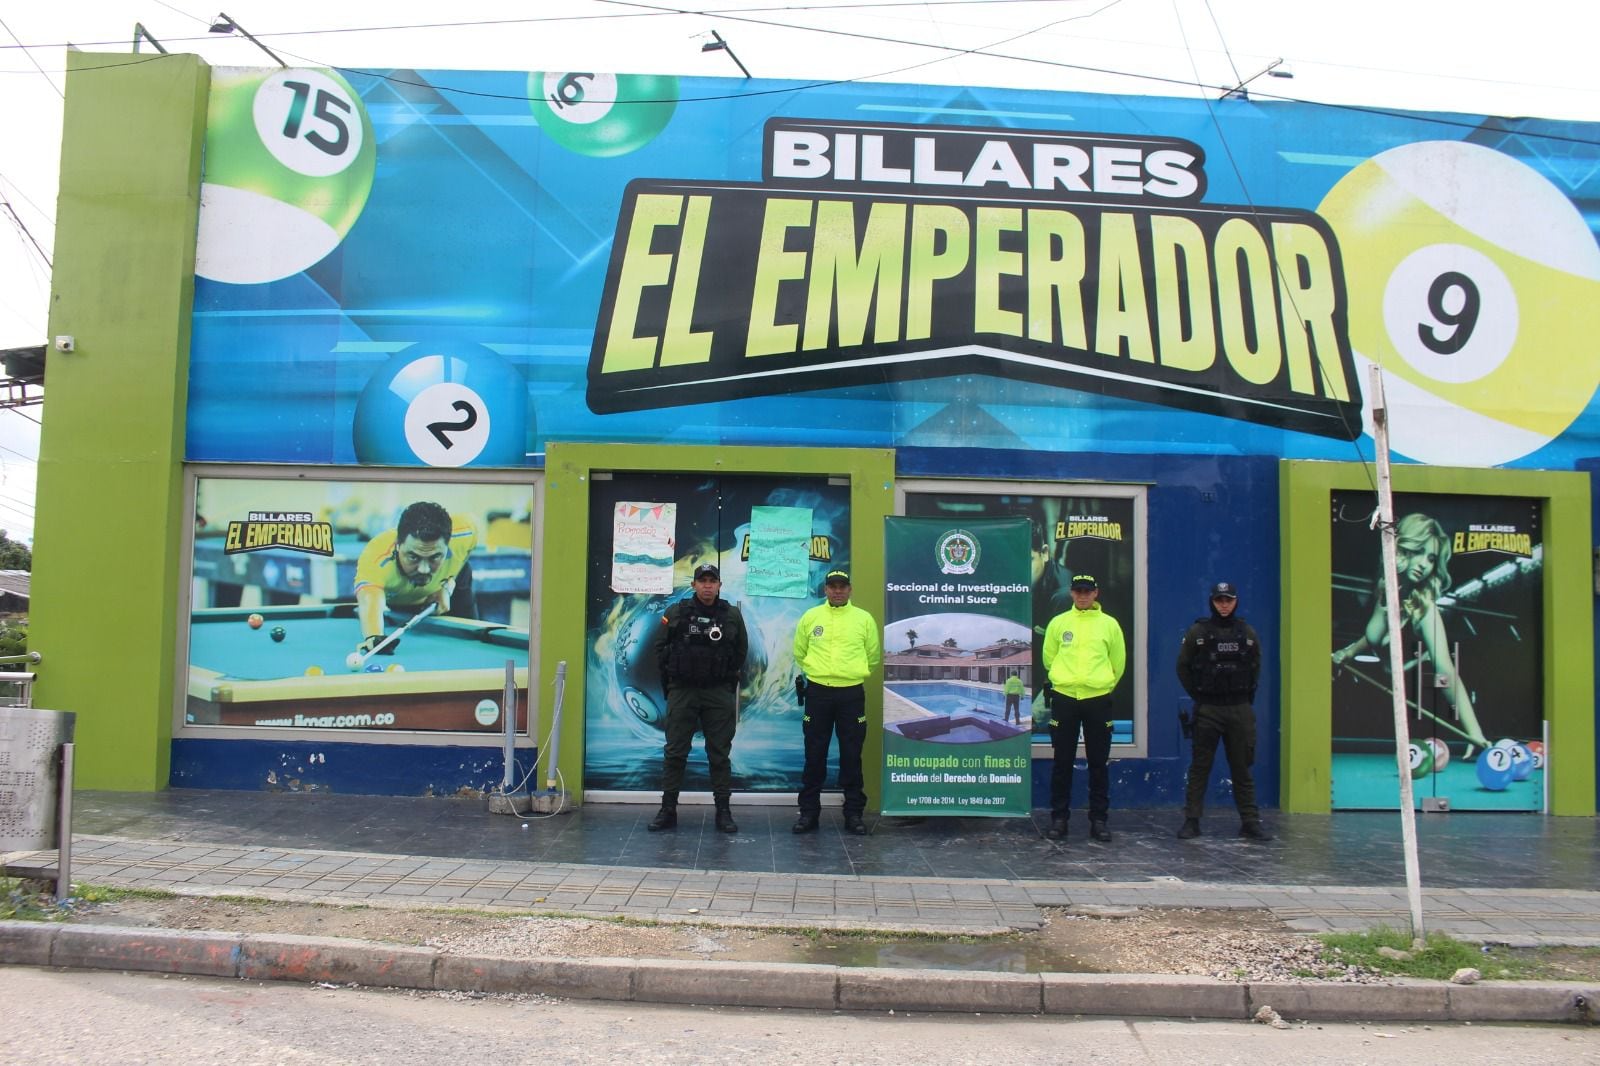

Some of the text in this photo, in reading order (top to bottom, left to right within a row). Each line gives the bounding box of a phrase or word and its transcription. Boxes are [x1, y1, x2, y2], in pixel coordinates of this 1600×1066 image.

[282, 80, 352, 156] 15
[773, 131, 1198, 198] BILLARES
[601, 193, 1351, 403] EL EMPERADOR
[1418, 271, 1480, 355] 9
[426, 400, 478, 450] 2
[249, 512, 312, 523] BILLARES
[1069, 515, 1109, 523] BILLARES
[1055, 522, 1122, 541] EL EMPERADOR
[1468, 524, 1516, 533] BILLARES
[226, 522, 333, 553] EL EMPERADOR
[1455, 532, 1531, 553] EL EMPERADOR
[887, 583, 1029, 595] Seccional de Investigación
[918, 594, 998, 604] Criminal Sucre
[886, 754, 1027, 770] Bien ocupado con fines de
[891, 772, 1022, 784] Extinción del Derecho de Dominio
[907, 796, 918, 805] Ley
[940, 796, 955, 805] 2014
[958, 796, 969, 806] Ley
[983, 797, 992, 805] de
[992, 797, 1006, 805] 2017
